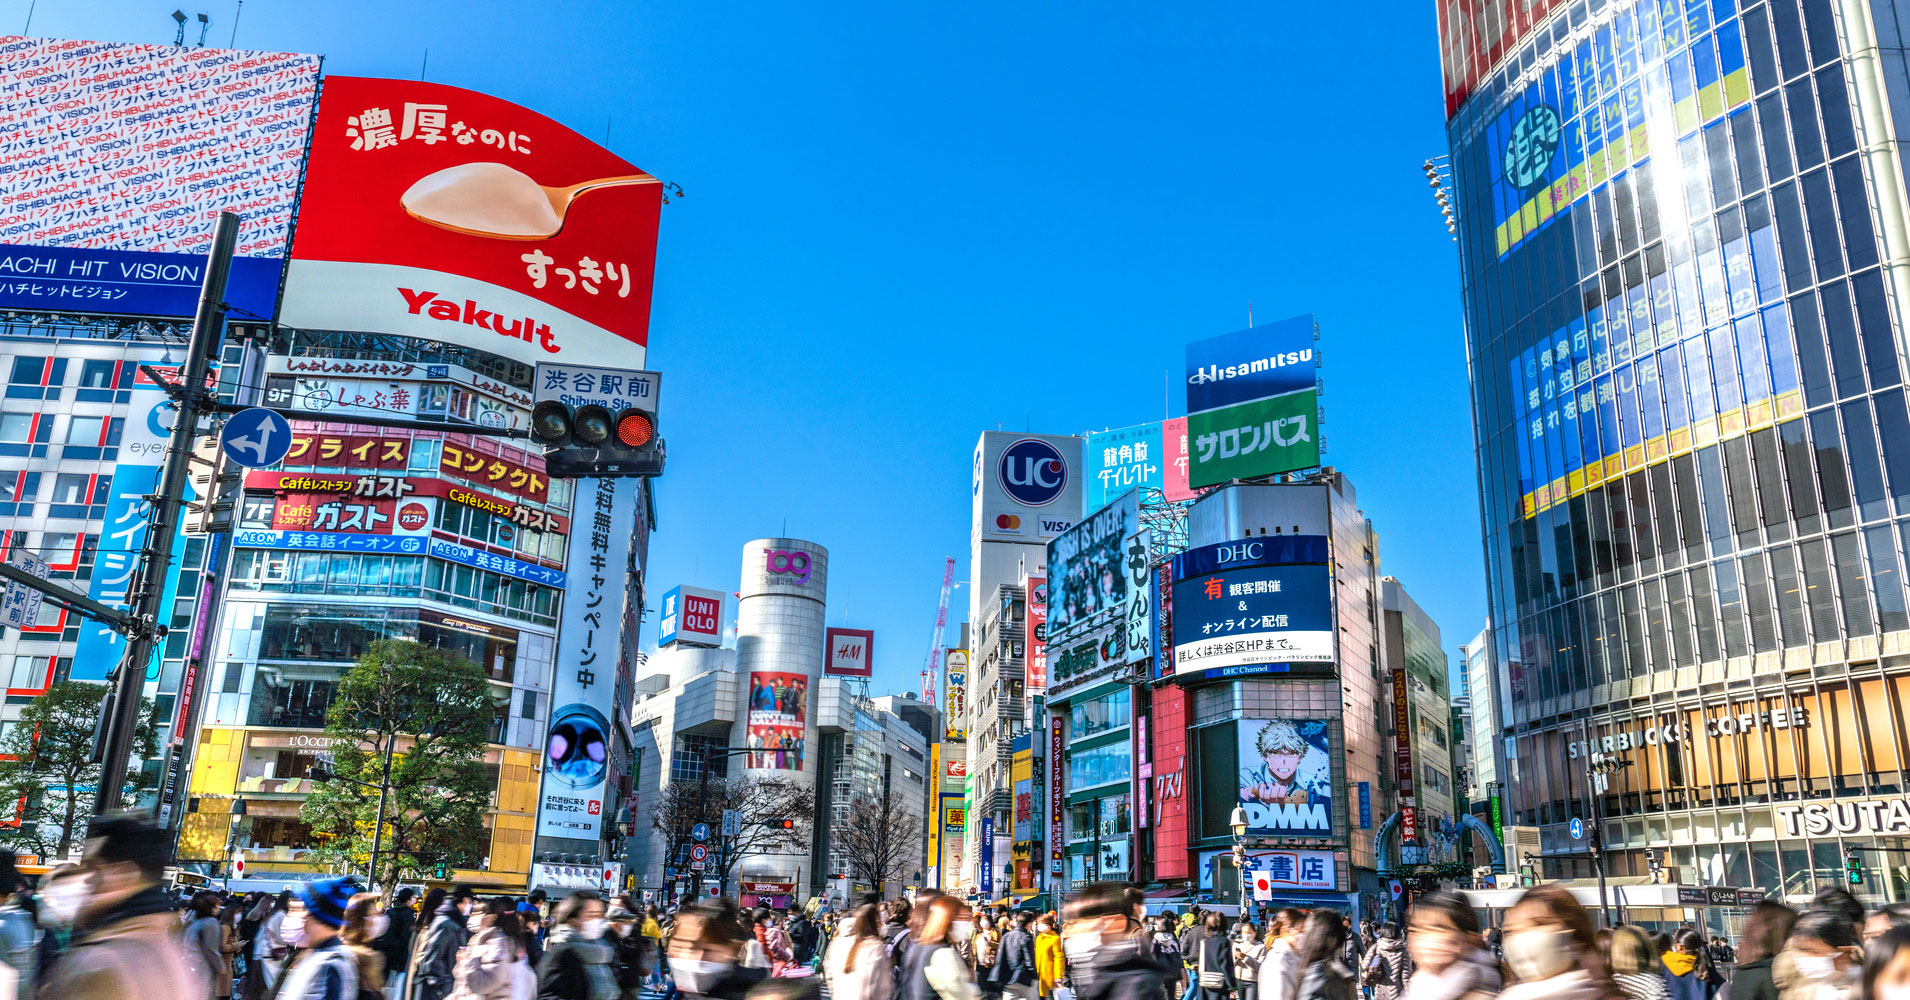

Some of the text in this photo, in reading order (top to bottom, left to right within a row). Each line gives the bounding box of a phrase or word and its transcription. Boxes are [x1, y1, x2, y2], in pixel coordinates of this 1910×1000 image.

[80, 46, 221, 85] SHIBUHACHI HIT VISION
[93, 55, 233, 92] SHIBUHACHI HIT VISION
[20, 108, 37, 118] HIT
[45, 99, 85, 112] VISION
[97, 69, 217, 100] シブハチヒットビジョン
[34, 56, 311, 125] HIT VISION シブハチヒットビジョン SHIBUHACHI
[345, 102, 531, 155] 濃厚なのに
[7, 113, 283, 182] シブハチヒットビジョン SHIBUHACHI HIT VISION
[20, 119, 297, 189] シブハチヒットビジョン SHIBUHACHI HIT VISION
[2, 134, 281, 204] SHIBUHACHI HIT VISION シブハチヒットビジョン
[16, 140, 295, 211] SHIBUHACHI HIT VISION シブハチヒットビジョン
[52, 189, 177, 223] シブハチヒットビジョン
[188, 169, 260, 191] SHIBUHACHI
[266, 162, 284, 172] HIT
[34, 198, 180, 238] SHIBUHACHI HIT VISION
[69, 260, 108, 278] HIT
[120, 262, 199, 282] VISION
[521, 248, 631, 297] すっきり
[397, 287, 562, 354] Yakult
[286, 358, 415, 377] しゃぶしゃぶバイキング
[1188, 347, 1312, 385] Hisamitsu
[544, 369, 651, 398] 渋谷駅前
[268, 387, 411, 411] 9F しゃぶ葉
[289, 437, 406, 464] プライス
[1195, 414, 1311, 464] サロンパス
[442, 445, 545, 494] コンタクト
[1103, 442, 1148, 467] 龍角散
[355, 475, 415, 498] ガスト
[245, 502, 273, 519] 7F
[279, 502, 389, 532] Café ガスト
[279, 517, 310, 527] レストラン
[401, 515, 426, 523] ガスト
[512, 502, 560, 532] ガスト
[239, 531, 419, 550] AEON 英会話イーオン 6F
[1041, 520, 1072, 533] VISA
[436, 543, 566, 587] AEON 英会話イーオン
[763, 547, 812, 584] 109
[1216, 541, 1264, 564] DHC
[9, 557, 34, 623] 渋駅前
[576, 474, 616, 691] 送料無料キャンペーン中
[1128, 536, 1149, 655] もんじゃ
[1204, 577, 1281, 600] 有 観客開催
[688, 600, 713, 616] UNI
[1238, 600, 1248, 611] &
[687, 614, 714, 630] QLO
[1202, 614, 1288, 635] オンライン配信
[837, 643, 861, 661] H&M
[1179, 638, 1294, 663] 詳しくは渋谷区HPまで。
[1223, 665, 1268, 676] DHC Channel
[1395, 672, 1412, 791] クスリのことなら 三千里
[950, 809, 964, 823] 薬
[1243, 803, 1330, 830] DMM
